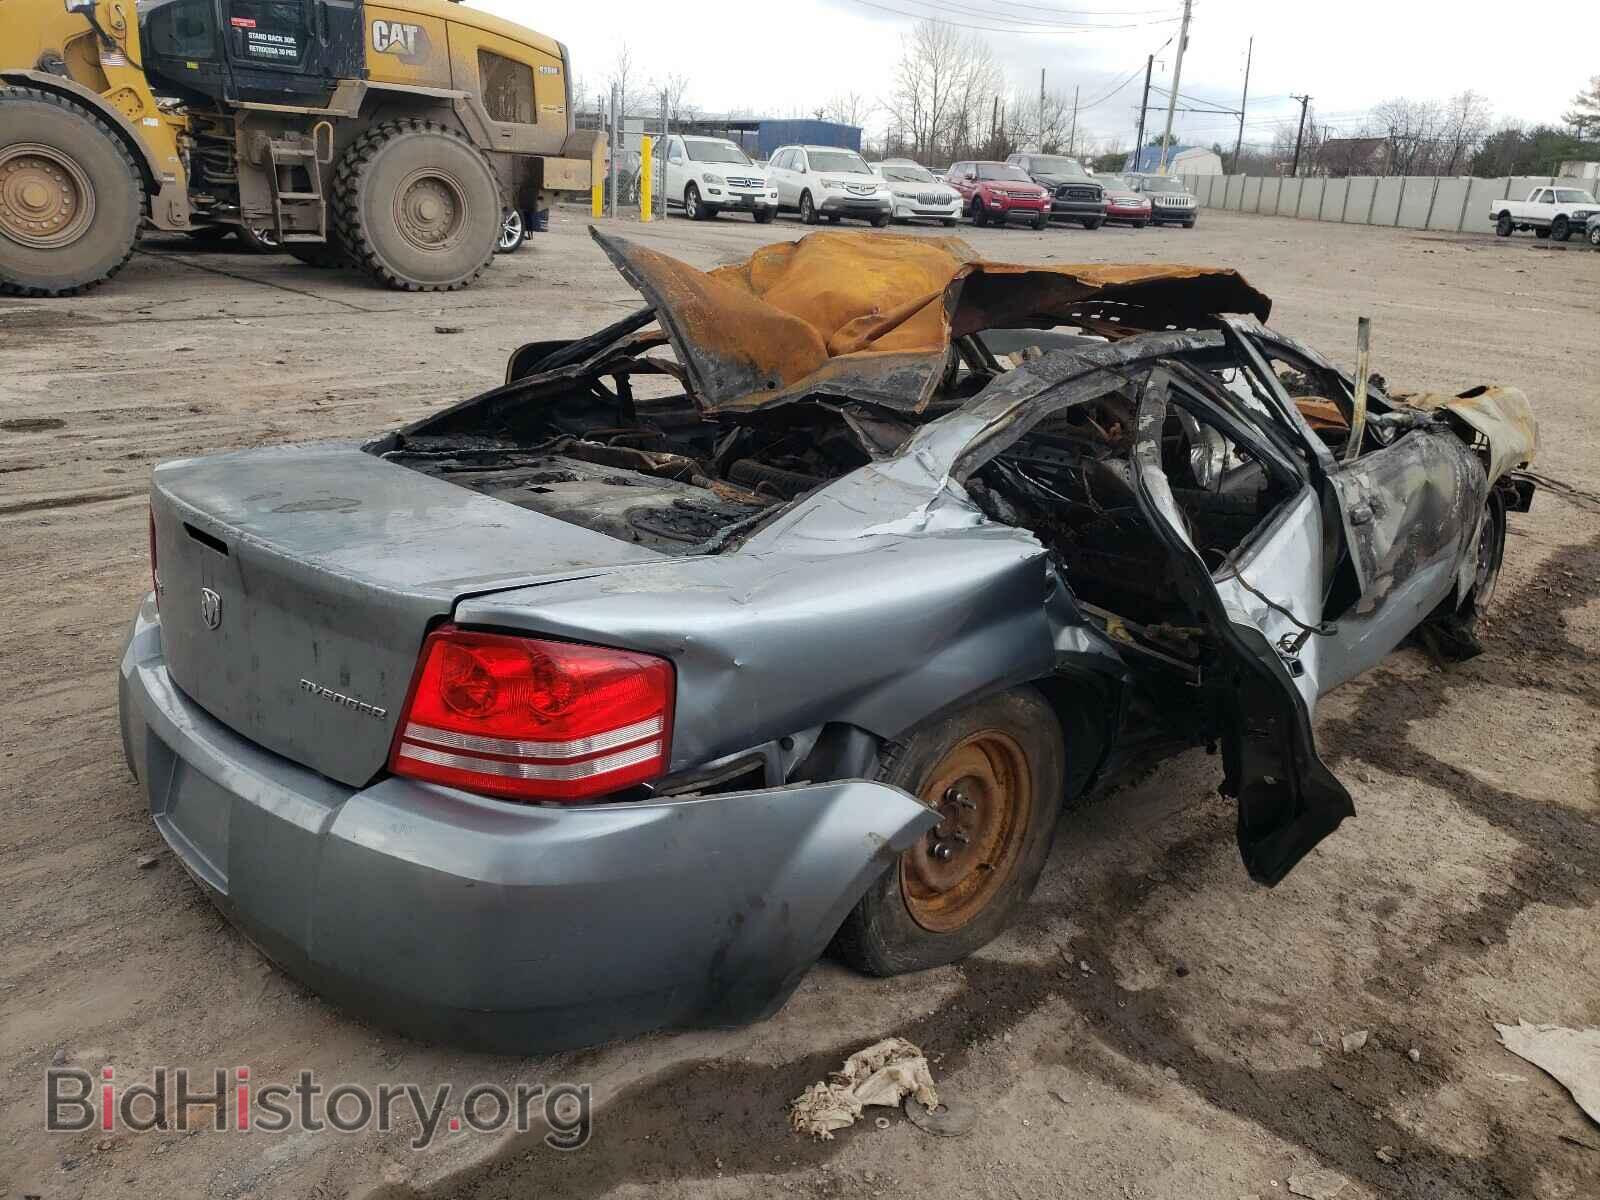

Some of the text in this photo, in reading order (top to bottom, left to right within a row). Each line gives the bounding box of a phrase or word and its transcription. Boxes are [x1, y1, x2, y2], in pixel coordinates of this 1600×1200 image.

[248, 32, 266, 41] STAND
[267, 34, 283, 42] BACK
[372, 20, 418, 54] CAT
[300, 678, 387, 720] AVENGER
